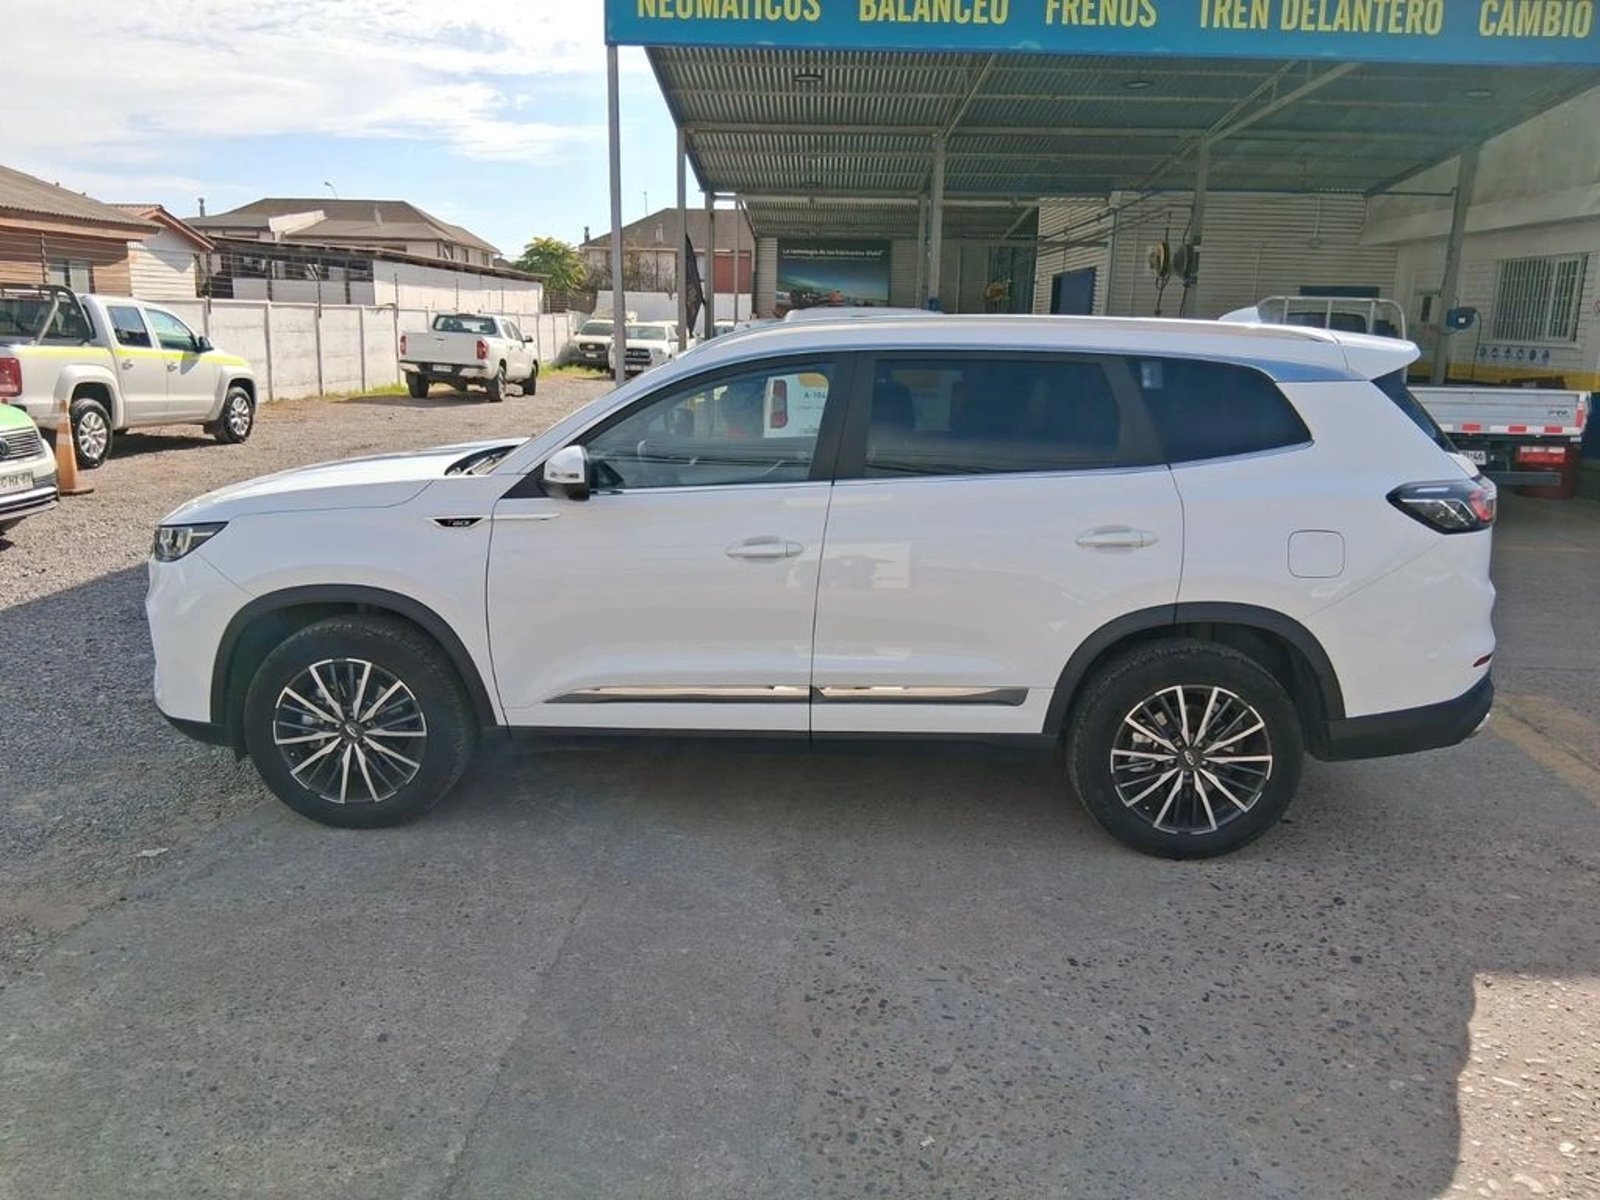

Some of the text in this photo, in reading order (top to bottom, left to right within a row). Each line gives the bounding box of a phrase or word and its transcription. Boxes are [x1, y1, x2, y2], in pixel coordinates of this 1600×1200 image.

[859, 0, 1008, 24] BALANCEO
[1045, 0, 1157, 27] FRENOS
[1199, 0, 1444, 35] TREN DELANTERO
[1479, 0, 1592, 38] CAMBIO
